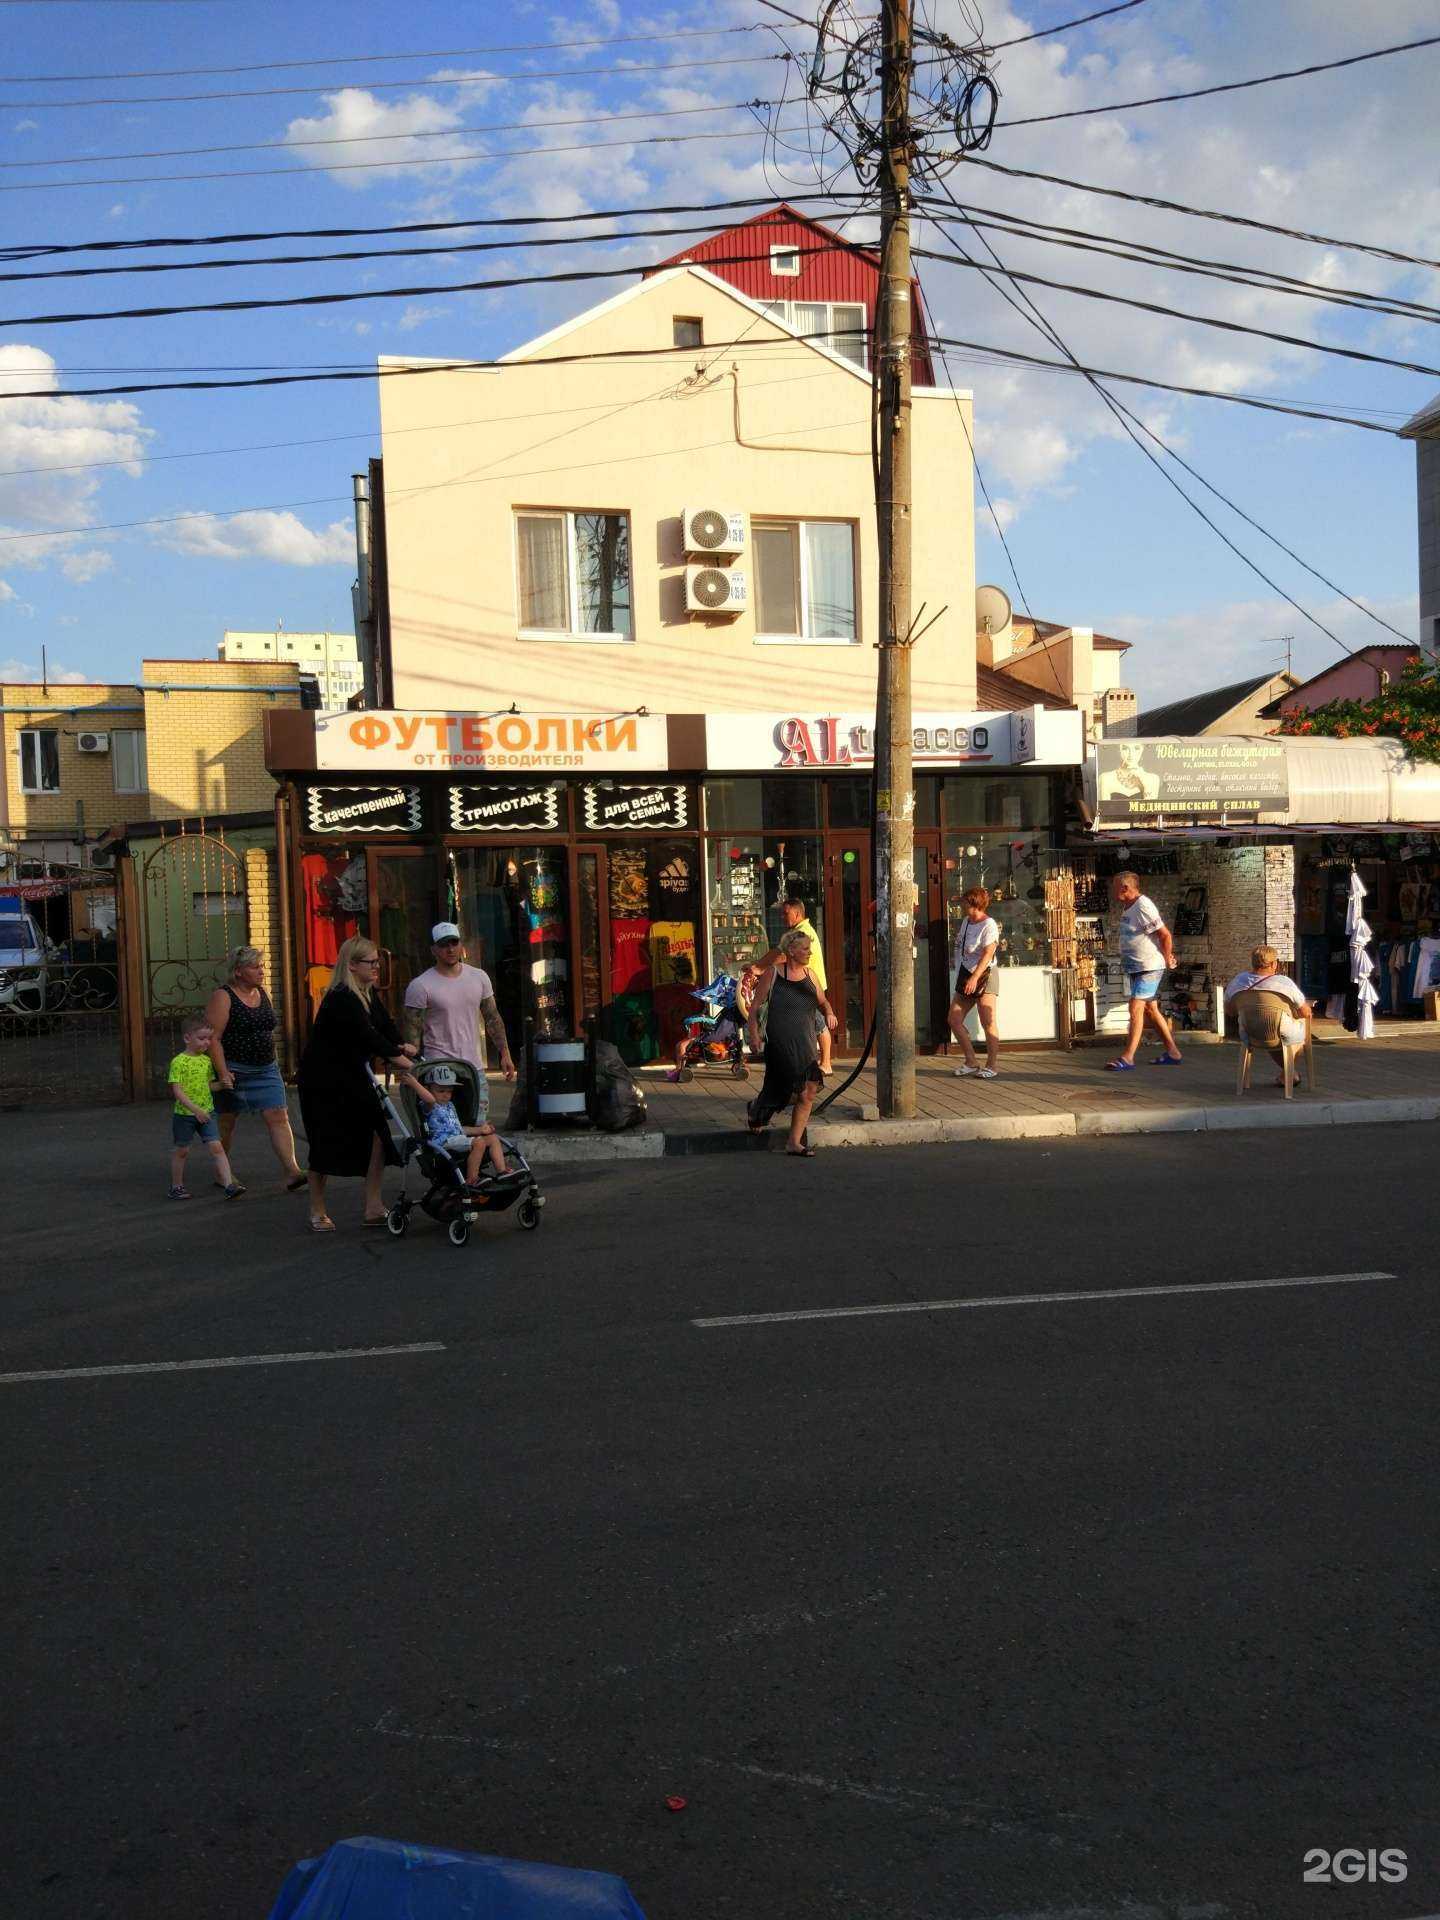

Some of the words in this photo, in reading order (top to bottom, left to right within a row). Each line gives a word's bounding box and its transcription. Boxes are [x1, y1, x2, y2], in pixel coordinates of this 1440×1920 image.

[350, 716, 637, 752] ФУТБОЛКИ
[856, 725, 989, 750] tacco
[414, 754, 436, 765] ОТ
[441, 754, 584, 767] ПРОИЗВОДИТЕЛЯ
[323, 789, 407, 823] качественный
[464, 793, 543, 821] ТРИКОТАЖ
[604, 801, 630, 818] ДЛЯ
[631, 791, 664, 809] ВСЕЙ
[629, 802, 671, 820] СЕМЬИ
